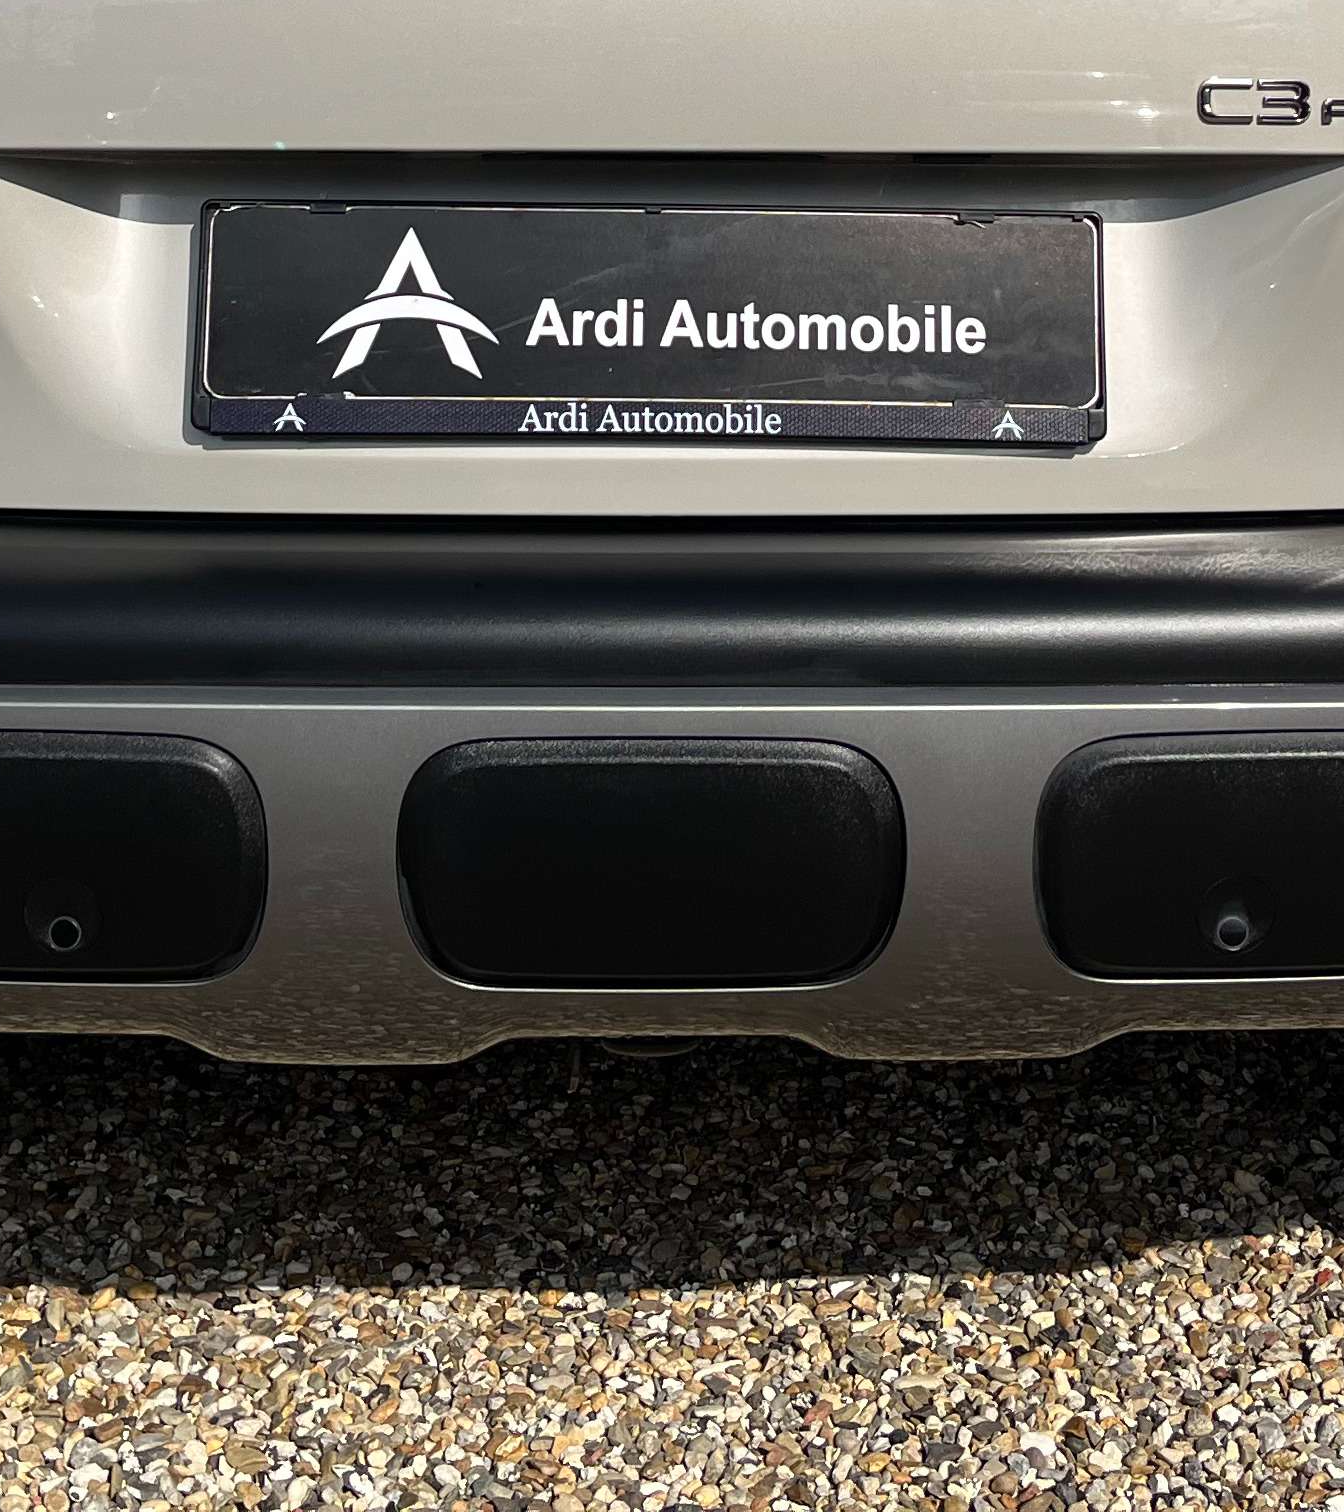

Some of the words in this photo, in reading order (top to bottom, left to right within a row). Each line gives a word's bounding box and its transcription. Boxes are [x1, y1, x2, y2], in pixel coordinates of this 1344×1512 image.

[1197, 75, 1311, 125] C3
[525, 297, 644, 348] Ardi
[659, 299, 987, 354] Automobile
[517, 402, 589, 433] Ardi
[596, 403, 782, 434] Automobile
